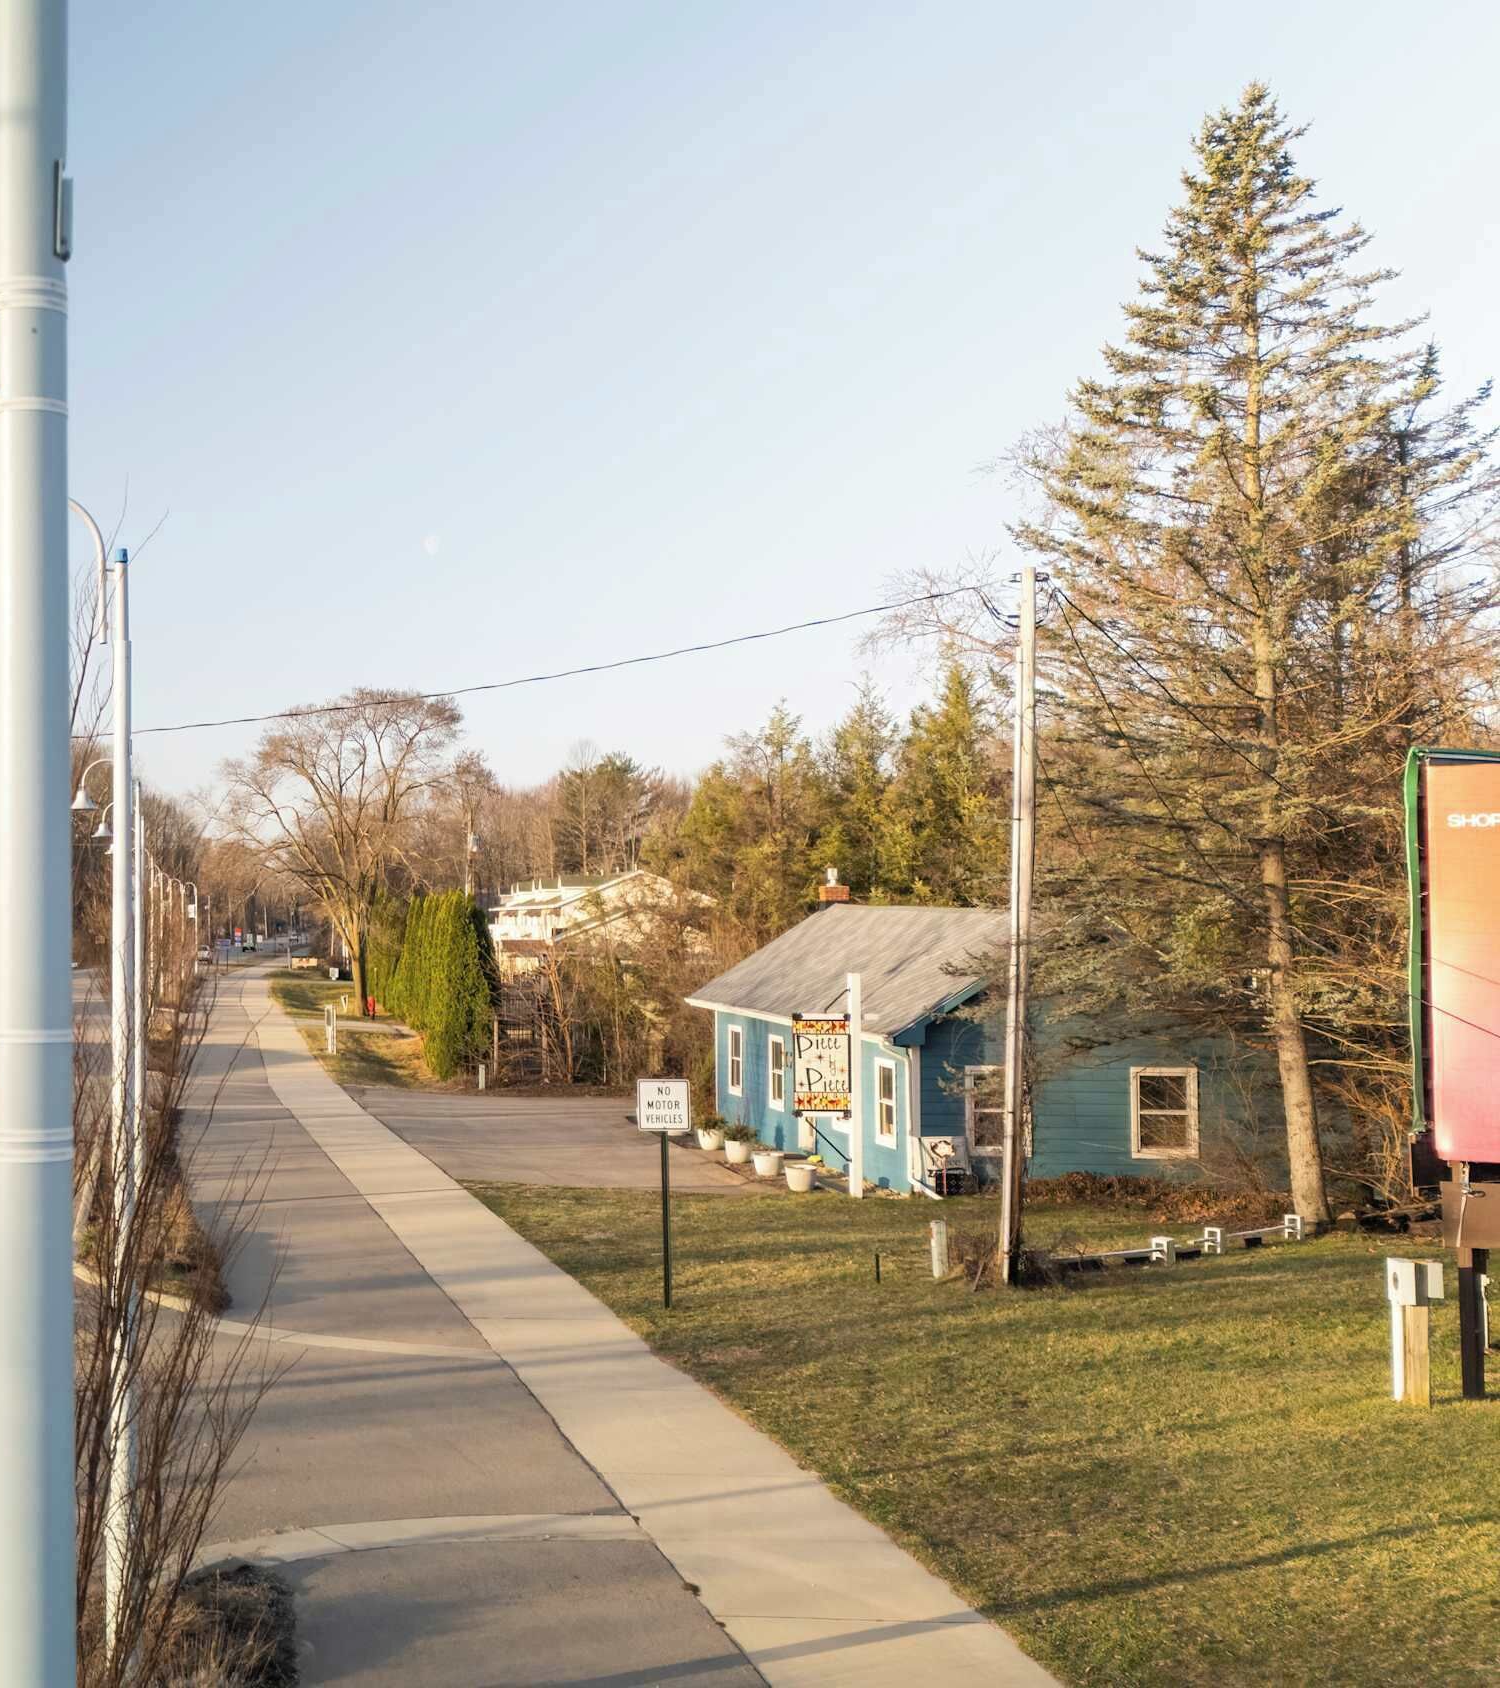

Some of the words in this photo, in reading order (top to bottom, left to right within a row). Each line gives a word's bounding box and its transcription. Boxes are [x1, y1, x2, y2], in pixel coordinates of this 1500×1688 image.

[796, 1035, 841, 1059] Piece
[806, 1067, 848, 1092] Piece
[657, 1086, 671, 1096] NO
[647, 1100, 680, 1110] MOTOR
[645, 1114, 683, 1124] VEHICLES
